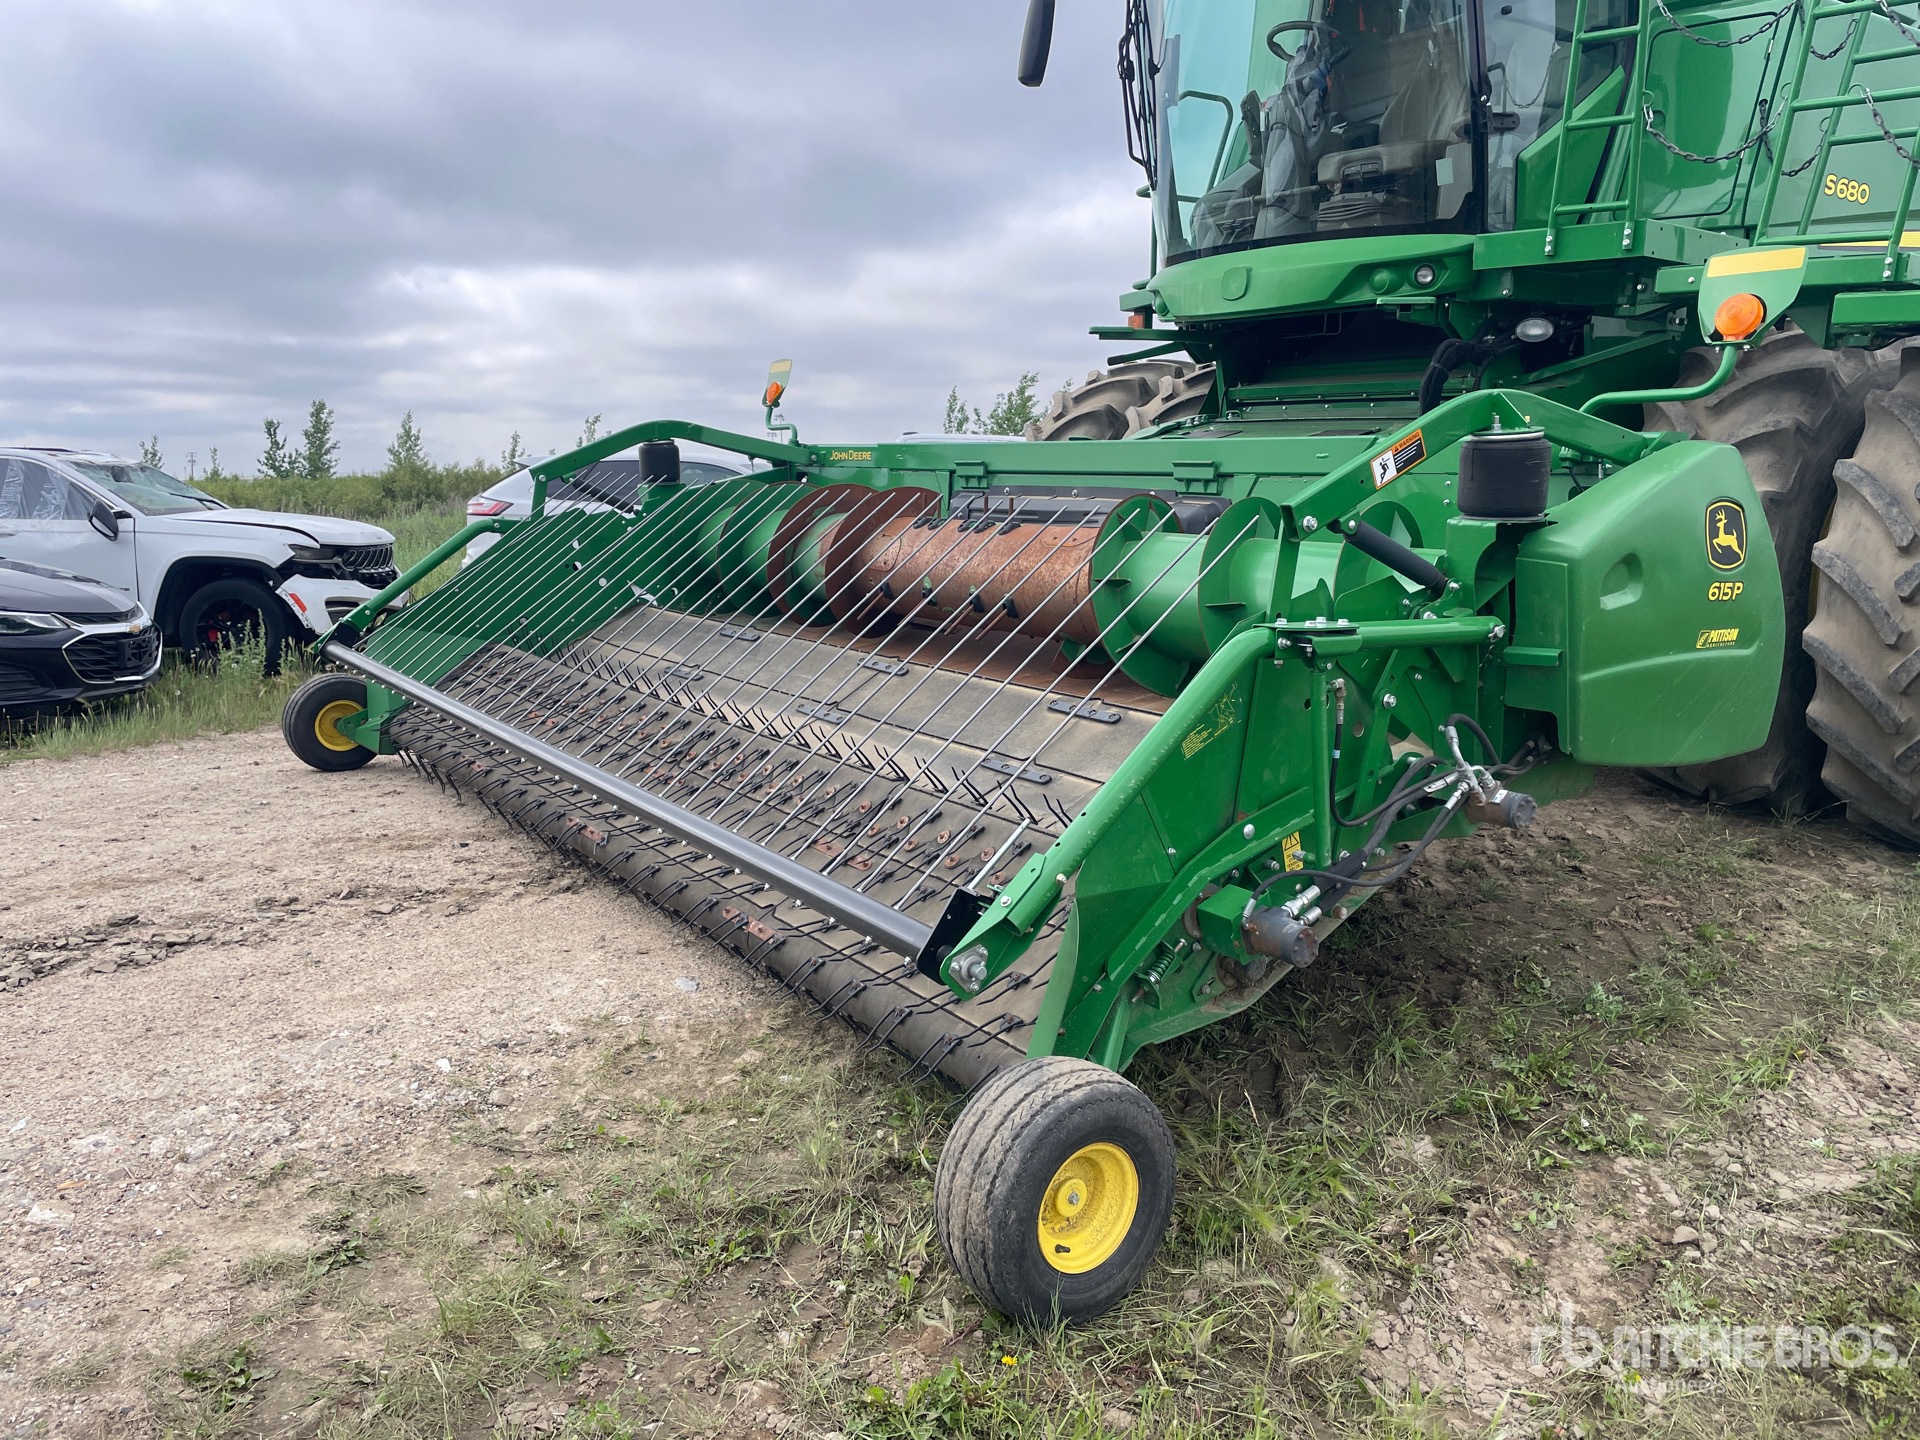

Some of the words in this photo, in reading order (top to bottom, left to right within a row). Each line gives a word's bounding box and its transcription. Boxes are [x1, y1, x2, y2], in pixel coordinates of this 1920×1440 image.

[1824, 173, 1870, 205] S680
[830, 450, 848, 460] JOHN
[848, 450, 872, 460] DEERE
[1708, 581, 1744, 601] 615P
[1708, 628, 1739, 642] PATTISON
